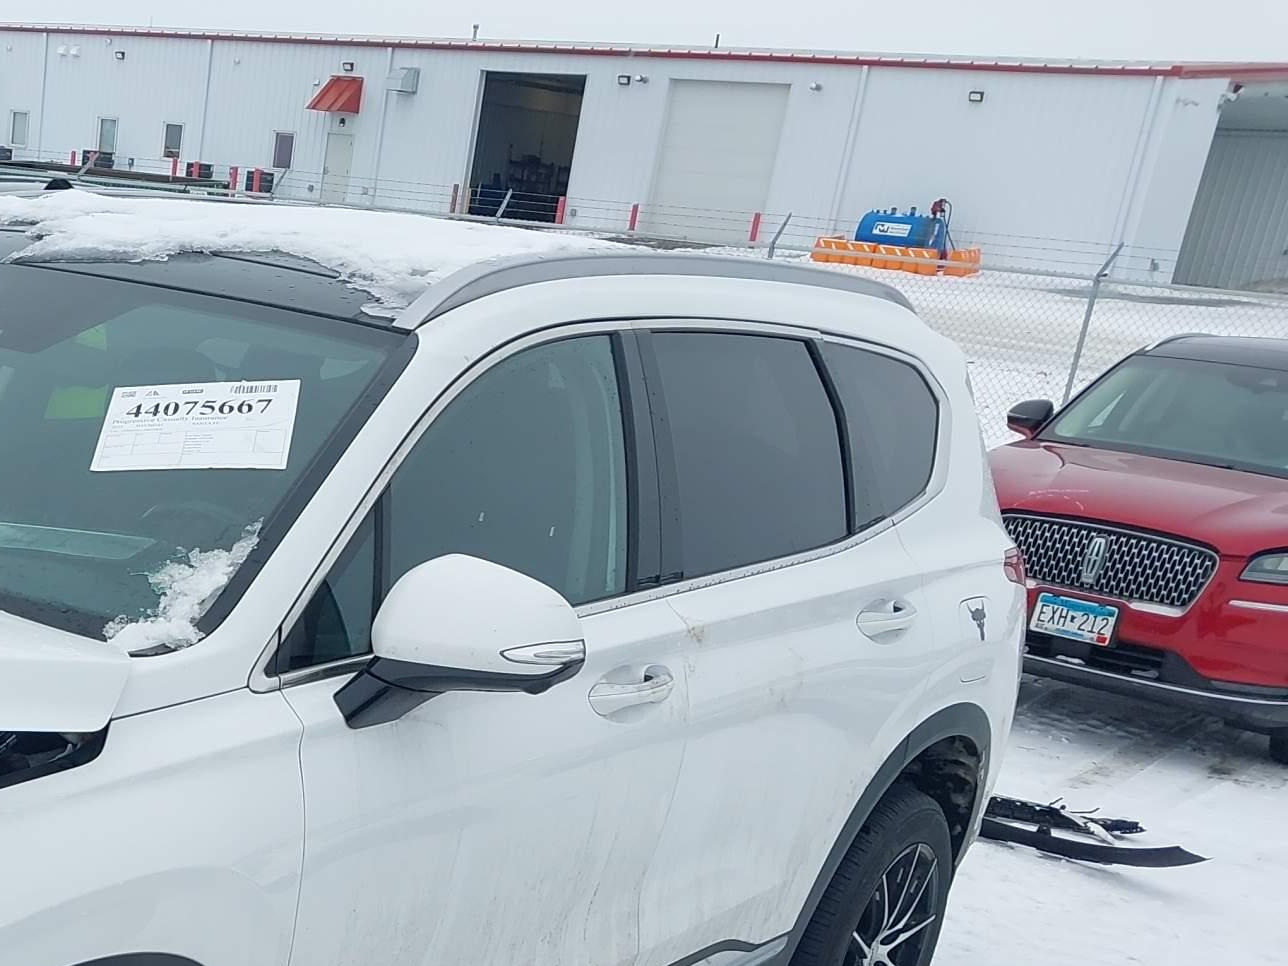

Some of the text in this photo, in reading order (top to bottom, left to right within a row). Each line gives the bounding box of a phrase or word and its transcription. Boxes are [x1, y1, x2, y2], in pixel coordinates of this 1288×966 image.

[126, 399, 273, 418] 44075667
[1037, 604, 1070, 627] EXH
[1077, 613, 1109, 635] 212
